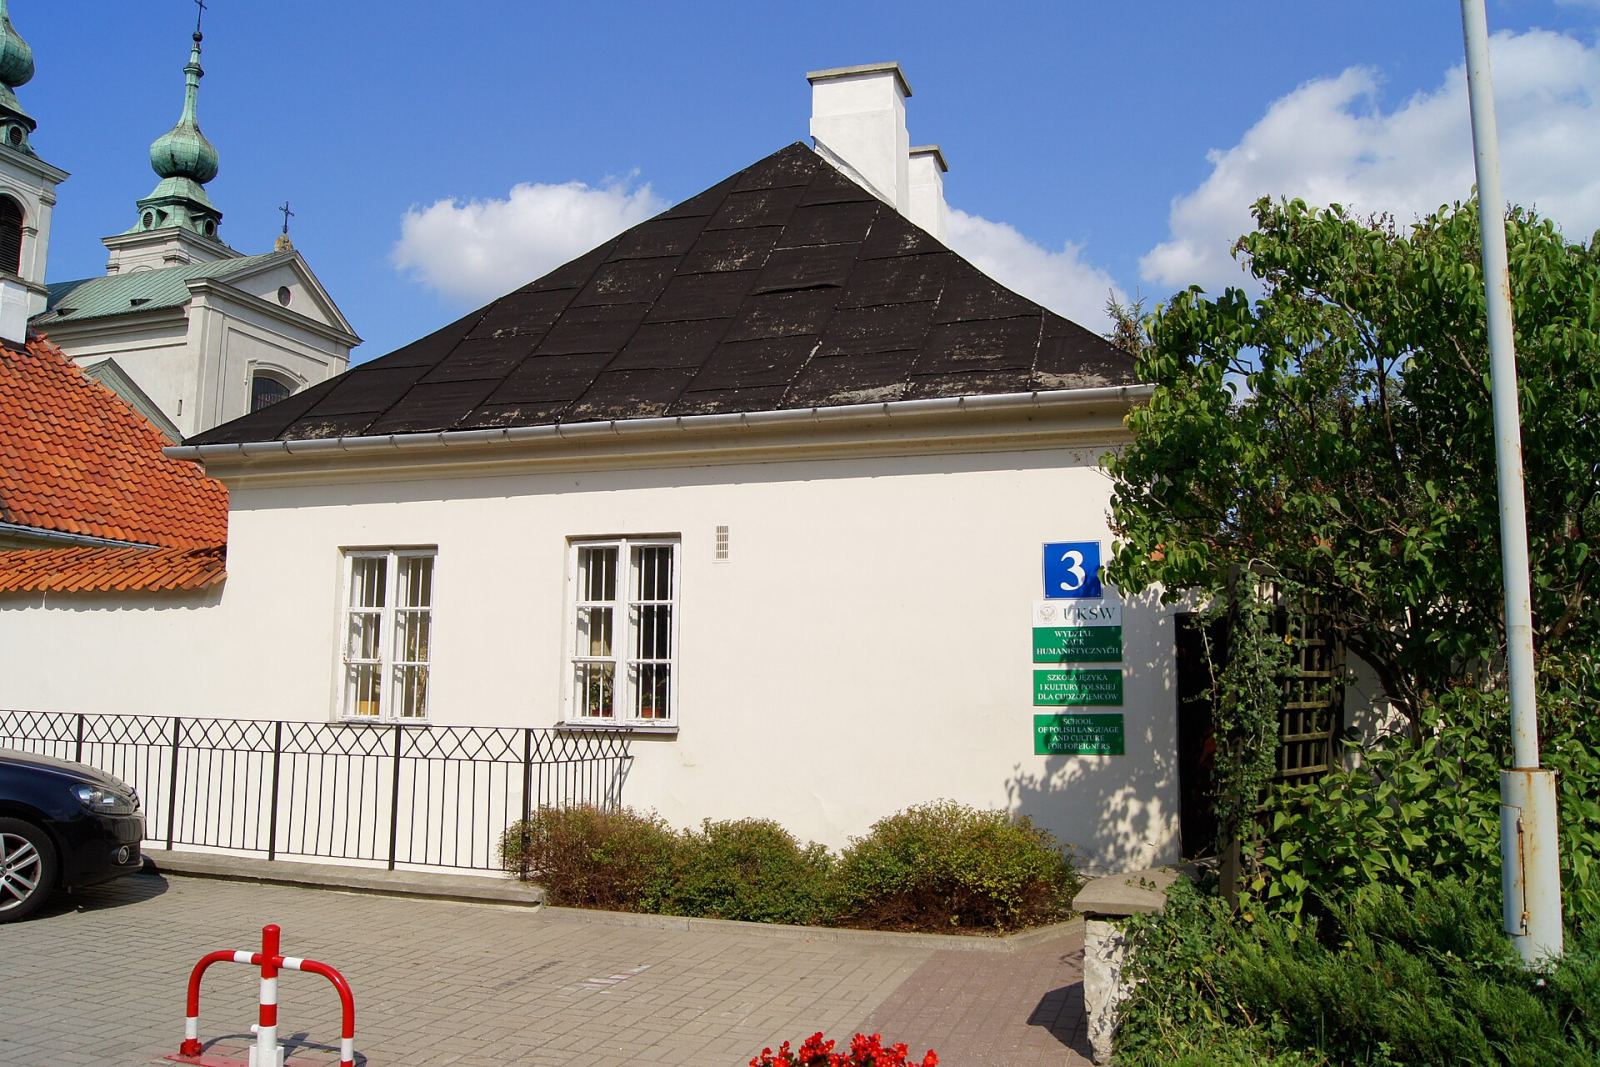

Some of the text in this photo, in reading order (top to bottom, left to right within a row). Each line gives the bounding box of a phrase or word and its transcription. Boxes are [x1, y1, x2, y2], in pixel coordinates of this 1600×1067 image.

[1060, 550, 1086, 591] 3
[1063, 607, 1116, 621] UKSW
[1062, 638, 1085, 646] NAUK
[1036, 647, 1120, 655] HUMANISTYCZNYCH
[1044, 683, 1079, 691] KULTURY
[1080, 683, 1116, 691] POLSKIEJ
[1037, 726, 1048, 734] OF
[1049, 726, 1076, 734] POLISH
[1052, 734, 1070, 742] AND
